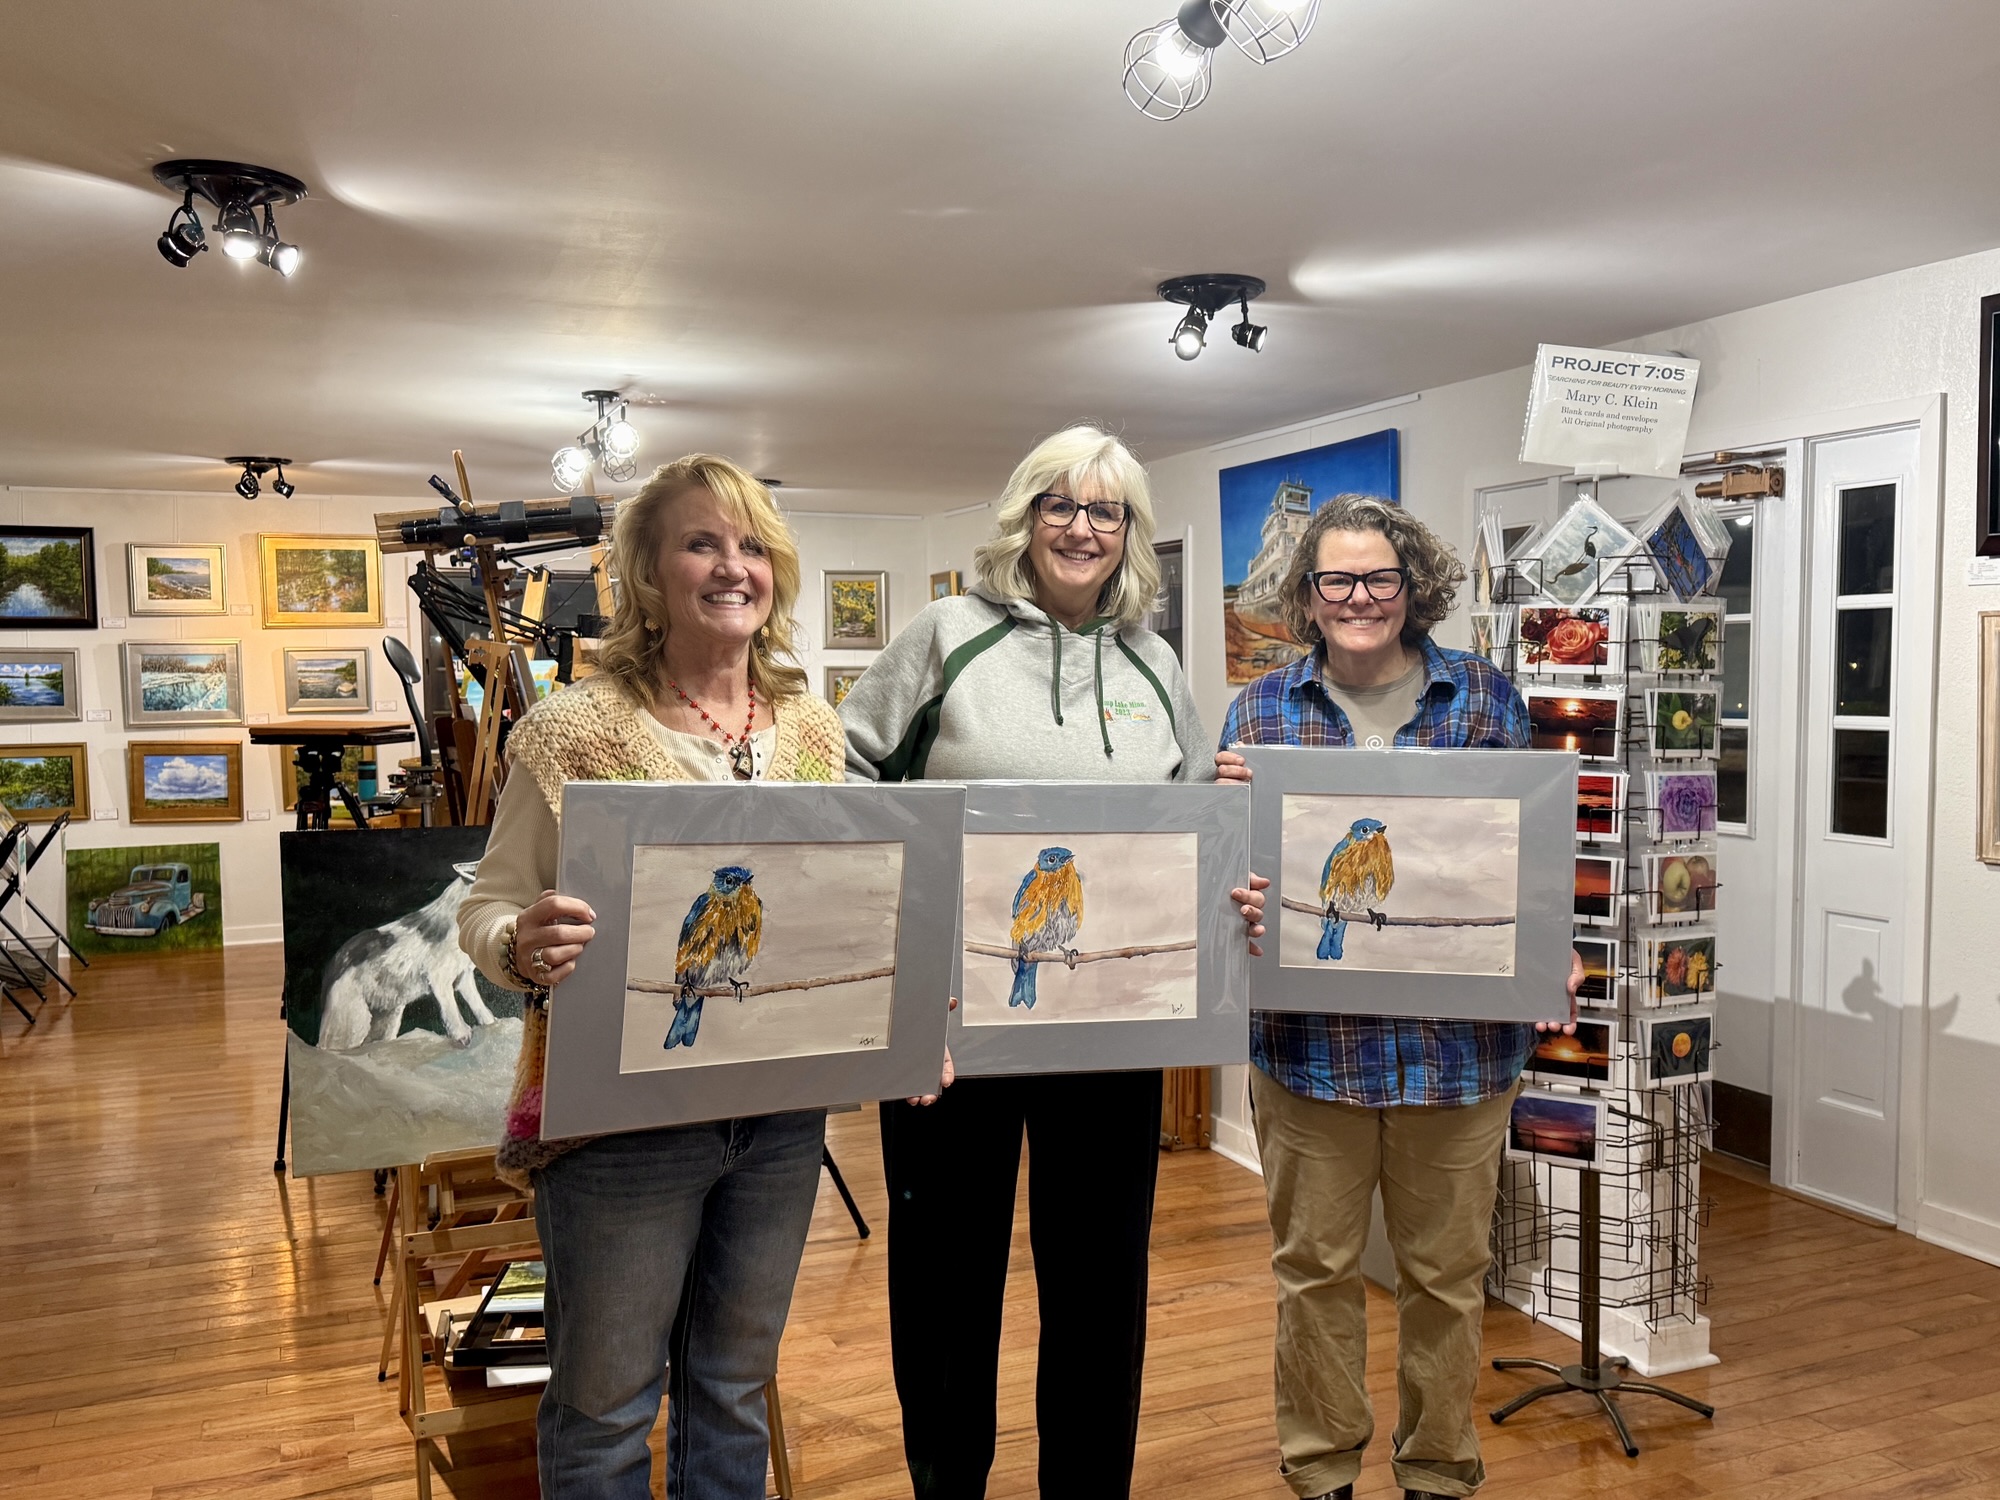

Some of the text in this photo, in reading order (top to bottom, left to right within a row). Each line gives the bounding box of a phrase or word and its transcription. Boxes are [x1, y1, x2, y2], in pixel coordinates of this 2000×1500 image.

[1552, 356, 1686, 381] PROJECT 7:05
[1548, 374, 1586, 384] SEARCHING
[1630, 384, 1652, 392] EVERY
[1652, 386, 1686, 395] MORNING
[1566, 388, 1658, 410] Mary C. Klein
[1561, 406, 1658, 424] Blank cards and envelopes
[1562, 416, 1653, 434] All Original photography
